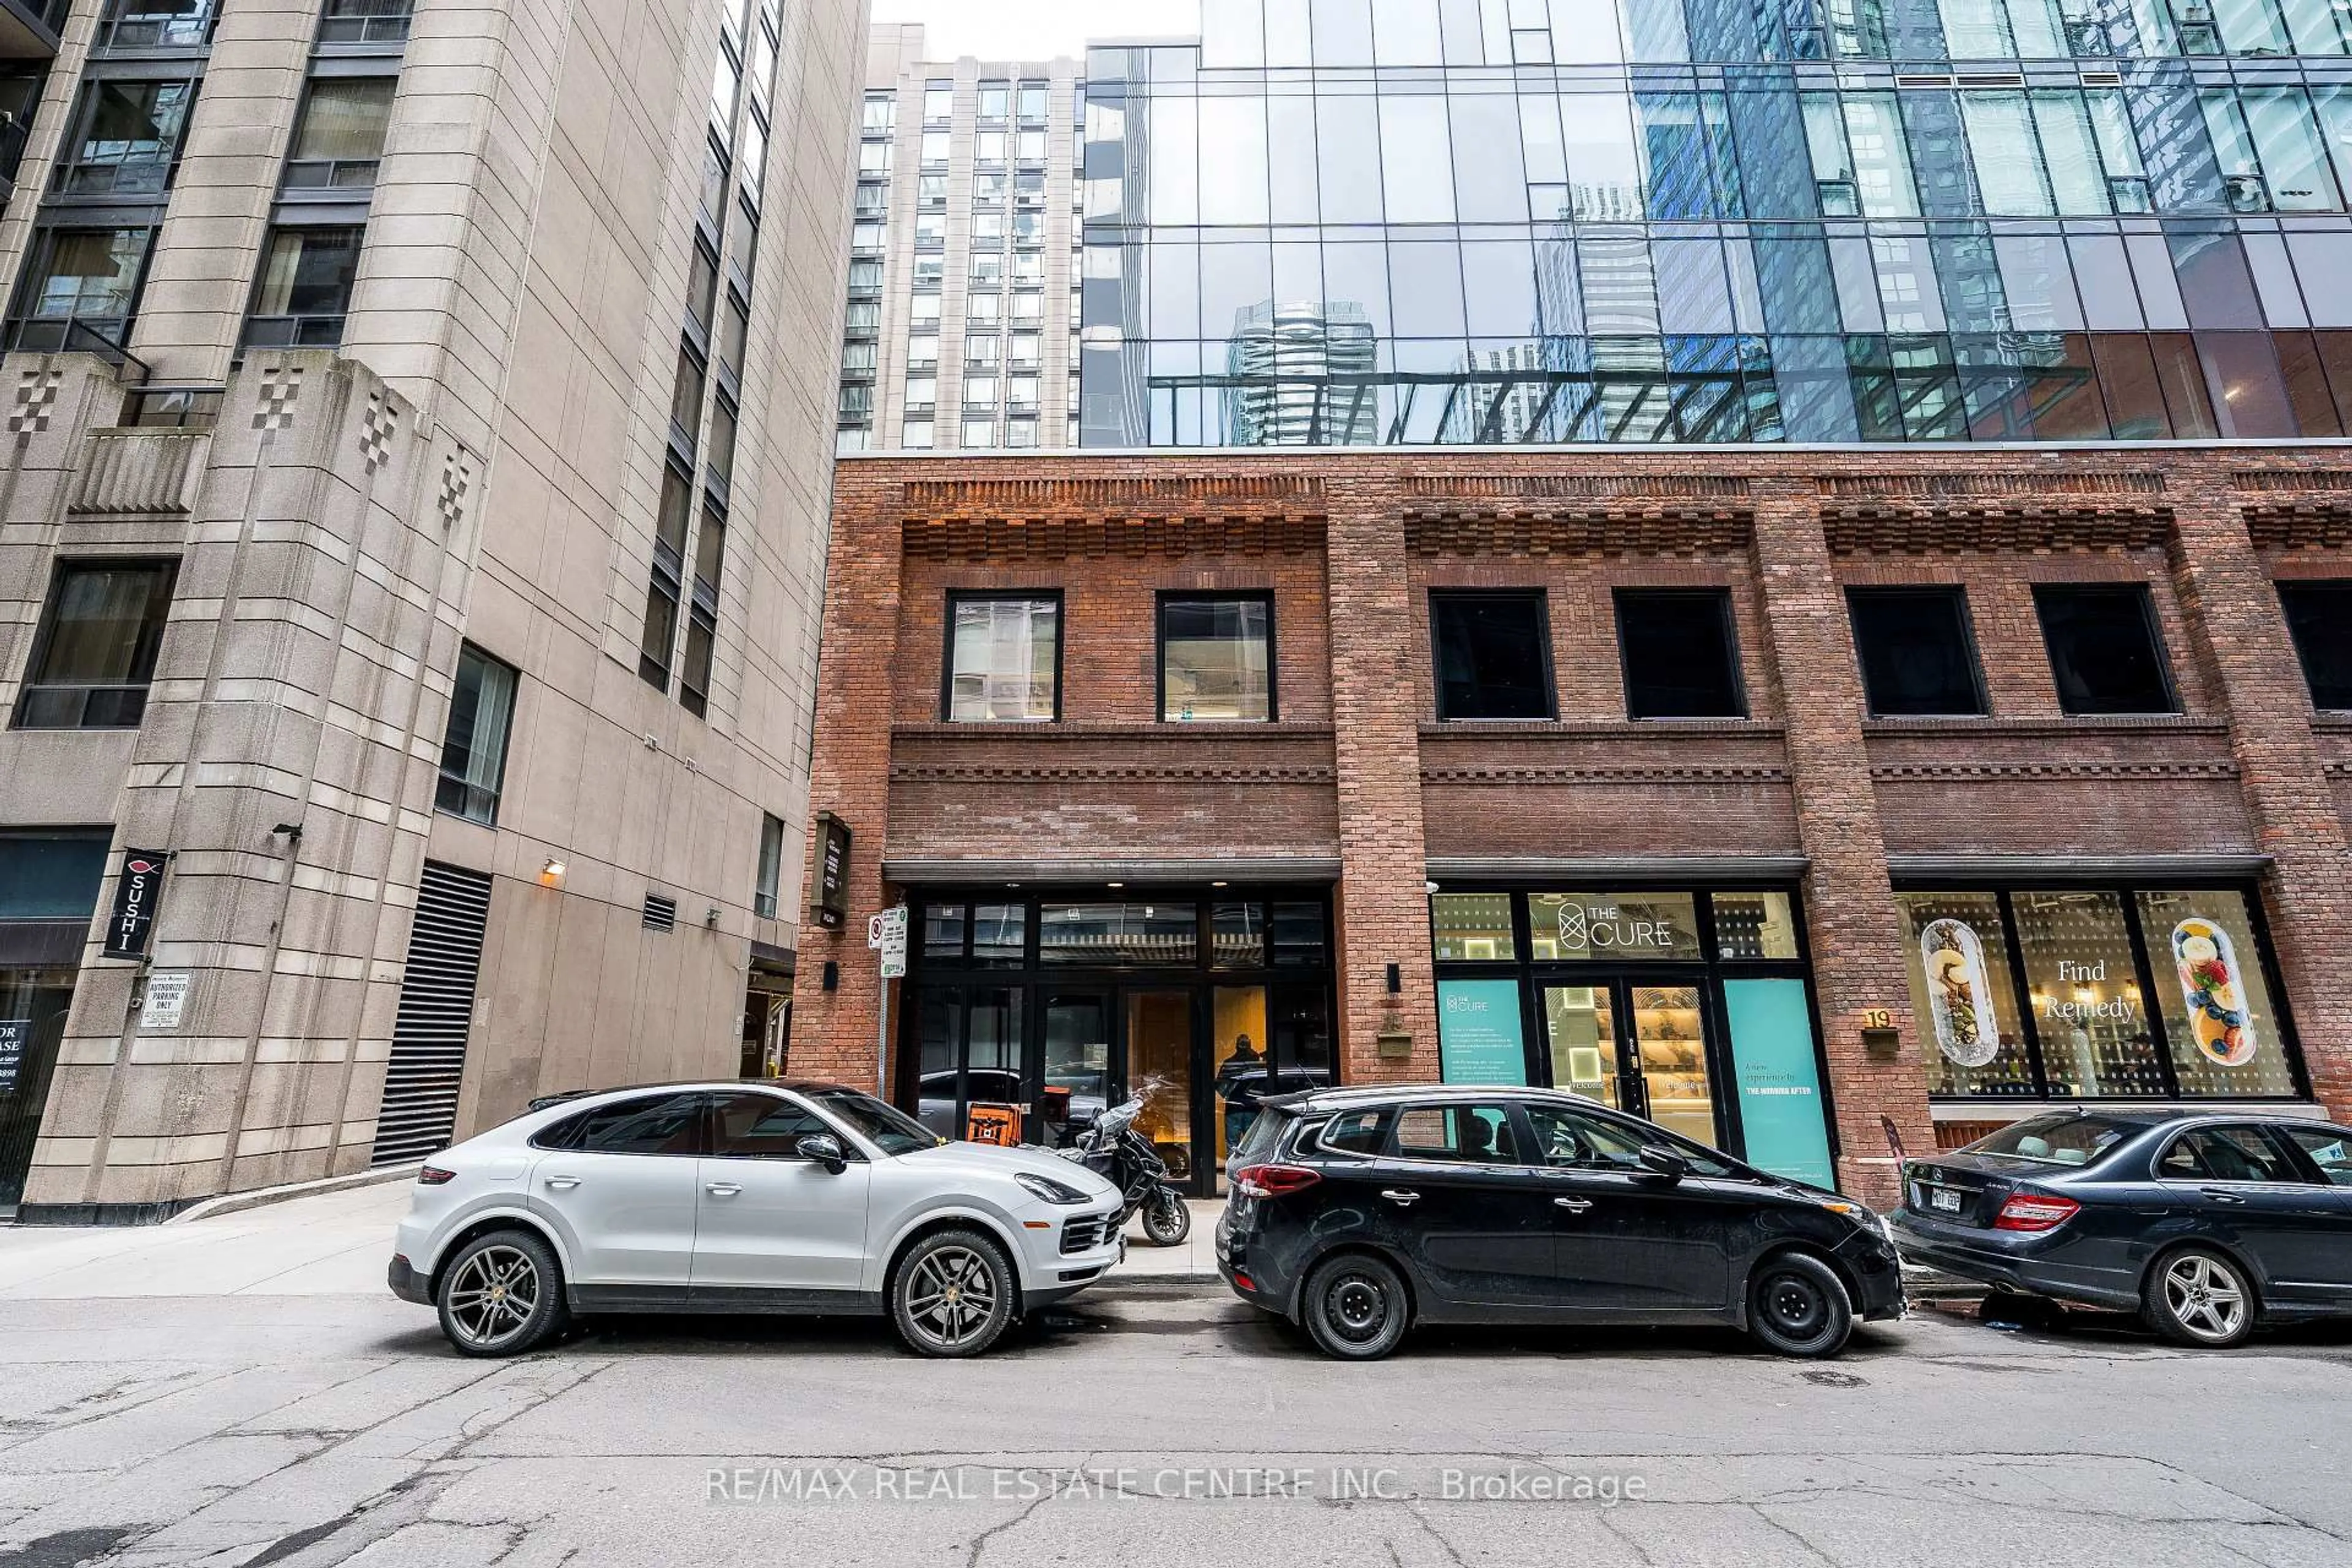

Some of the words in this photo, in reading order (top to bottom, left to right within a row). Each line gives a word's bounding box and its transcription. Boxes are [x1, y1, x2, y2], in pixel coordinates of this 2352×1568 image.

[119, 875, 145, 950] SUSHI
[1589, 908, 1618, 919] THE
[1591, 922, 1673, 946] CURE
[2058, 959, 2107, 981] Find
[156, 1001, 172, 1009] ONLY
[1458, 1002, 1489, 1011] CURE
[2044, 996, 2135, 1024] Remedy
[1868, 1011, 1890, 1029] 19
